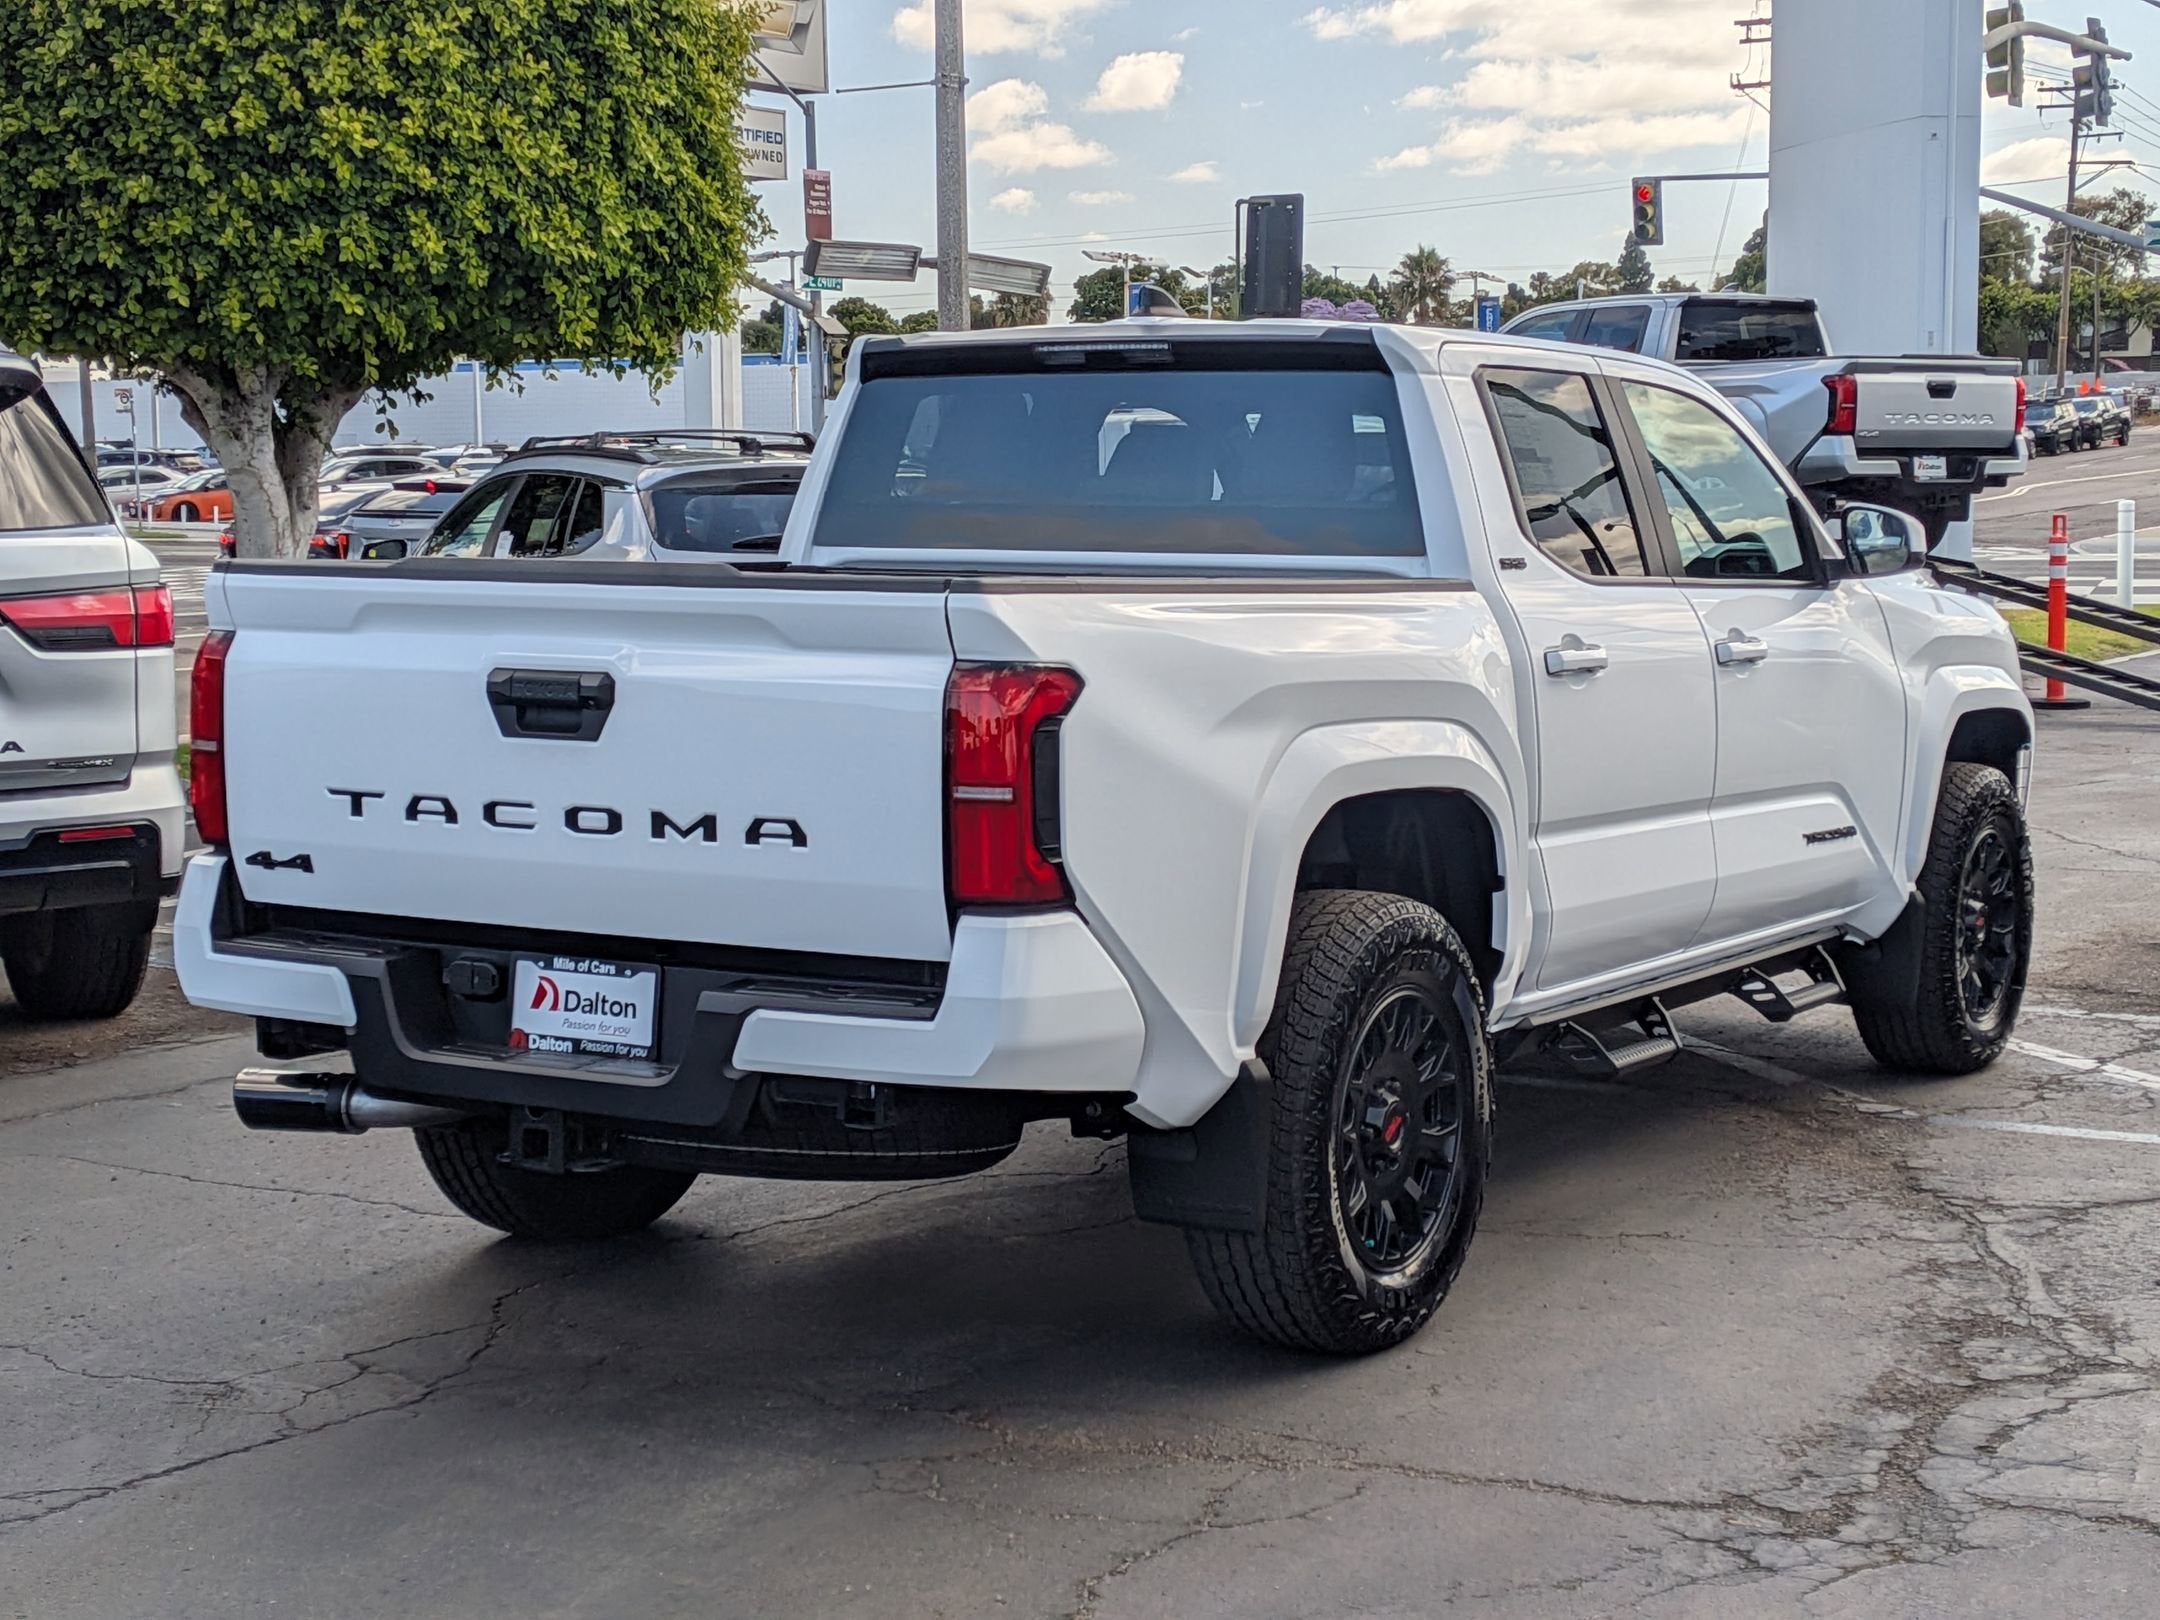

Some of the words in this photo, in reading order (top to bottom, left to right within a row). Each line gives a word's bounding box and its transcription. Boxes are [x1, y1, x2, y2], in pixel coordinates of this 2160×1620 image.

[1885, 413, 1994, 425] TACOMA
[326, 788, 808, 849] TACOMA
[553, 957, 575, 971] Mile
[577, 960, 589, 973] of
[591, 962, 616, 975] Cars
[563, 990, 637, 1019] Dalton
[562, 1018, 596, 1031] Passion
[597, 1021, 612, 1032] for
[612, 1025, 631, 1035] you
[528, 1034, 573, 1053] Dalton
[580, 1039, 614, 1053] Passion
[614, 1042, 629, 1055] for
[628, 1046, 648, 1058] you
